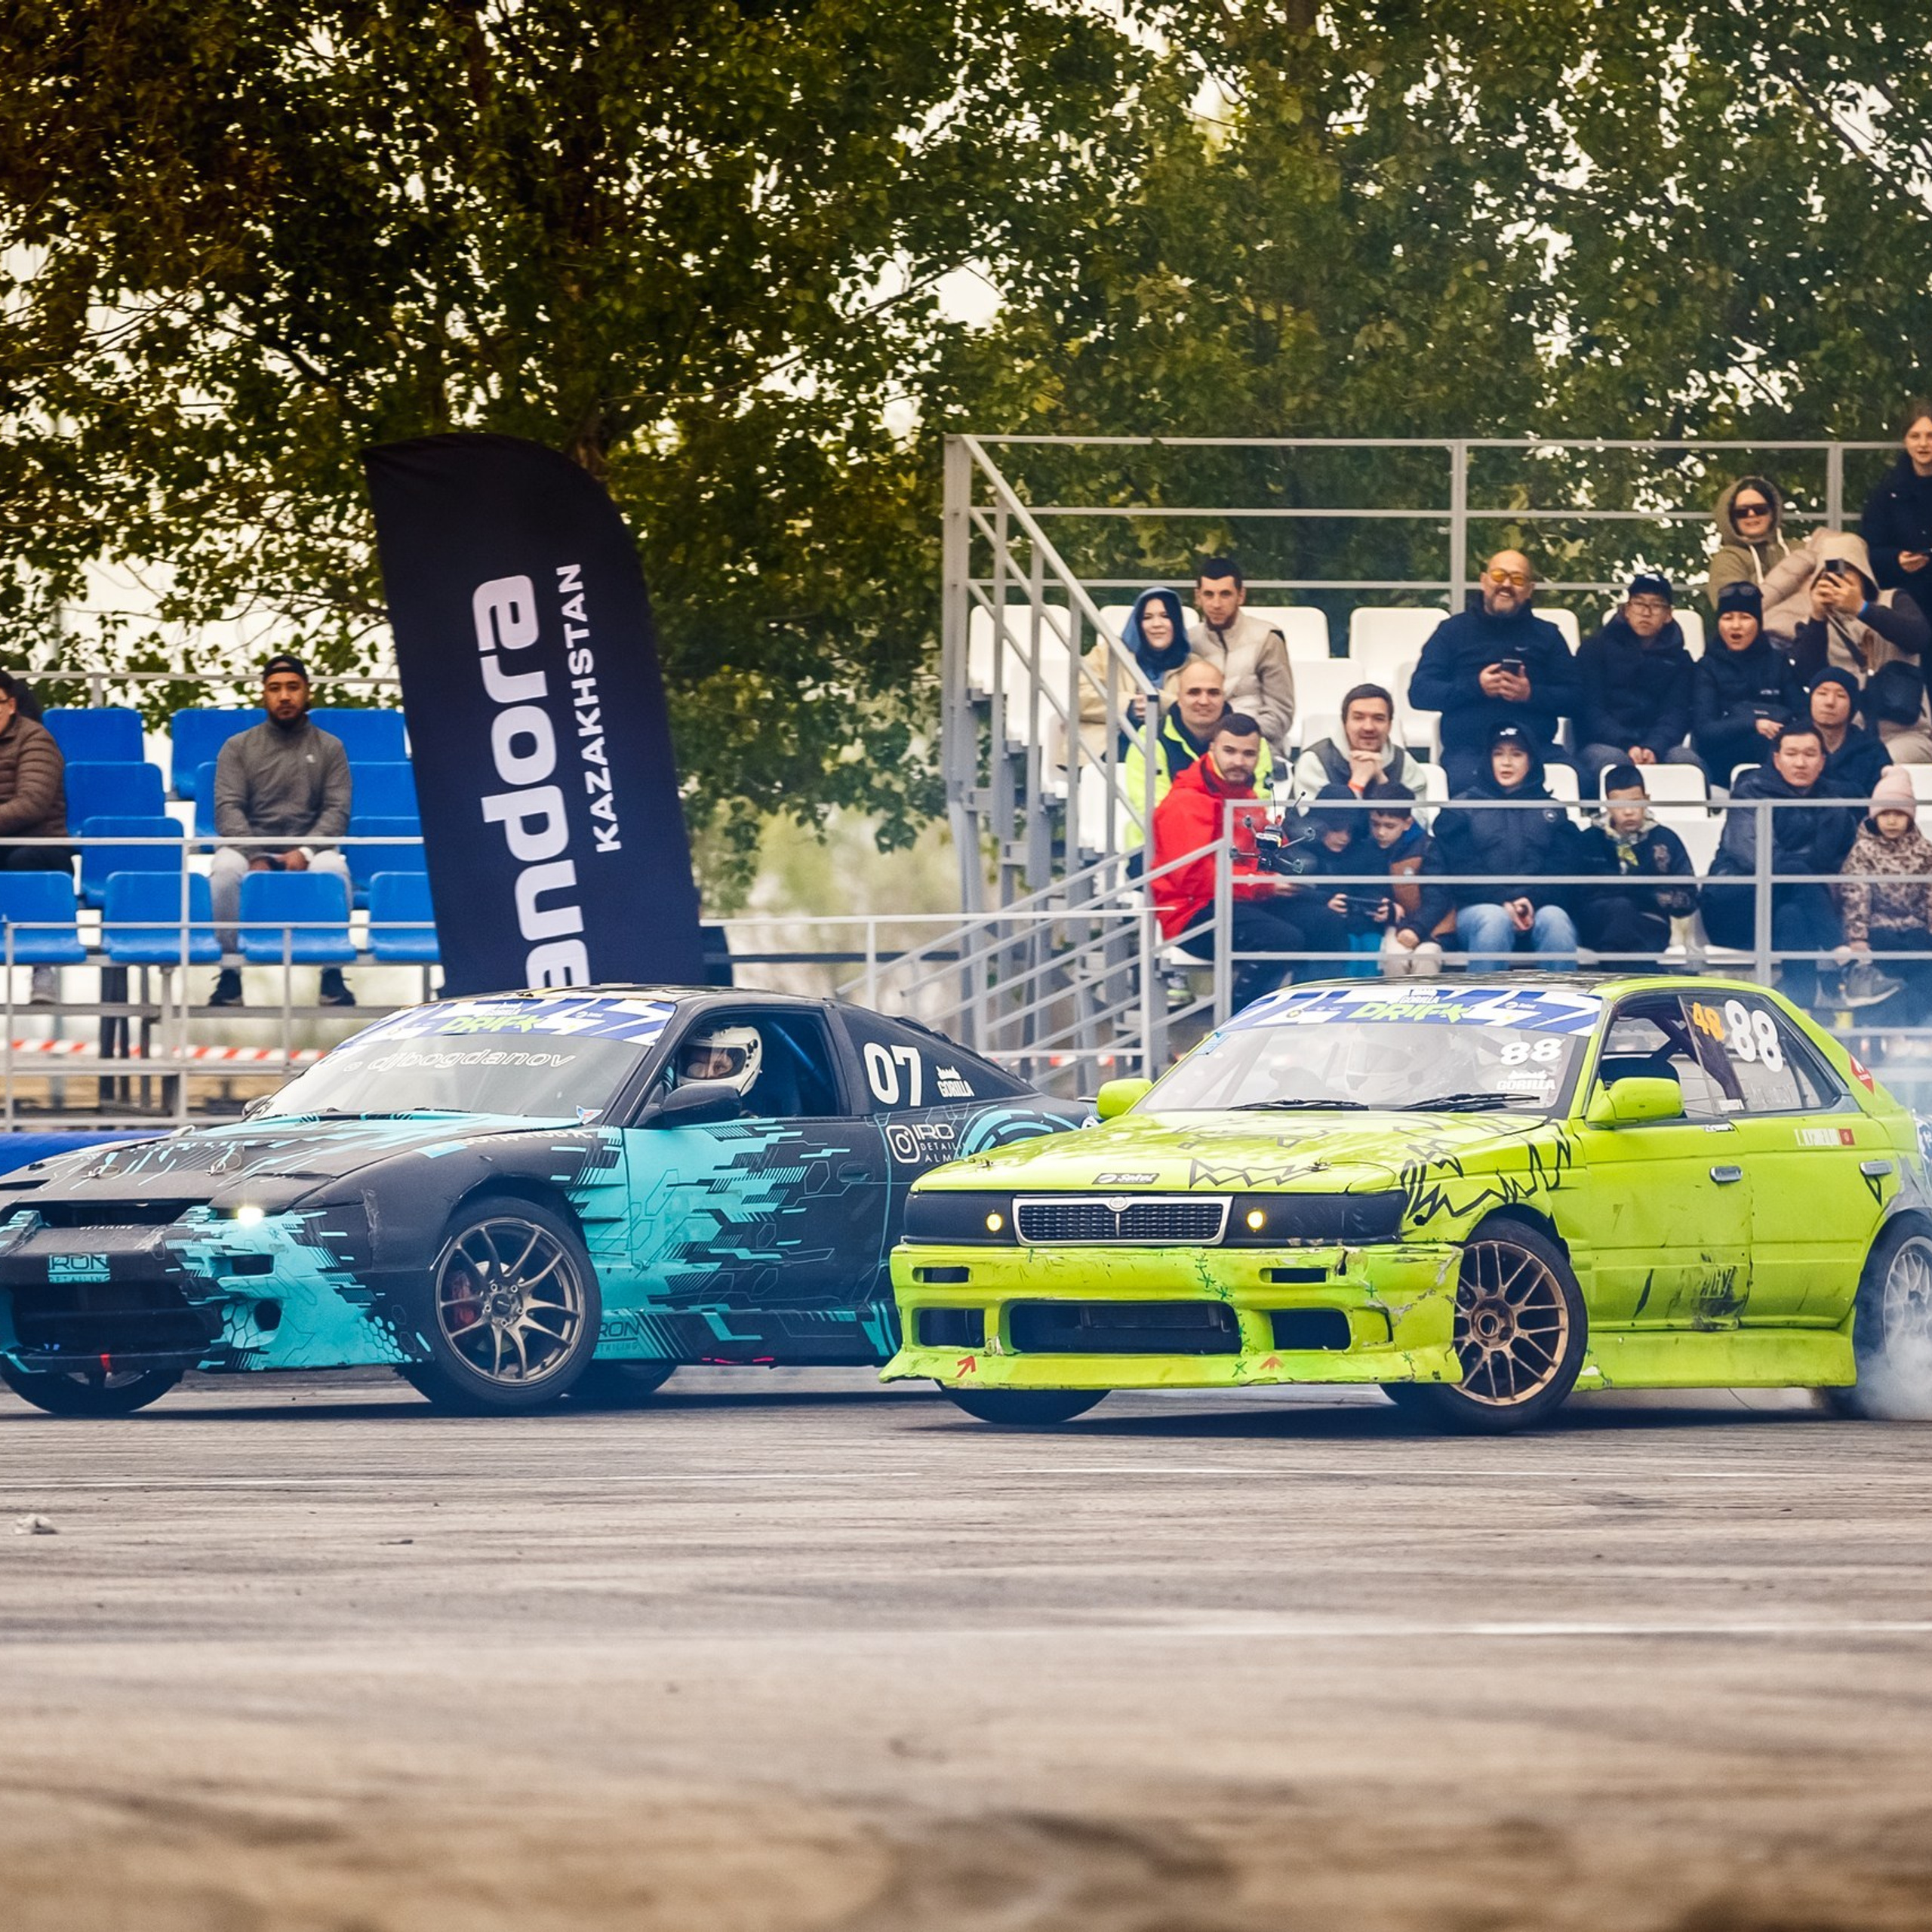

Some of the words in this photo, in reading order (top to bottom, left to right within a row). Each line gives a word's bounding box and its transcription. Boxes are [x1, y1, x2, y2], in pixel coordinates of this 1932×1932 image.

[556, 564, 622, 853] KAZAKHSTAN
[1346, 1002, 1472, 1023] DRIFT
[1693, 1001, 1725, 1041] 48
[1724, 999, 1783, 1072] 88
[368, 1049, 577, 1072] djbogdanov
[1500, 1038, 1563, 1066] 88
[863, 1042, 922, 1106] 07
[1497, 1079, 1556, 1090] GORILLA
[937, 1080, 975, 1097] GORILLA
